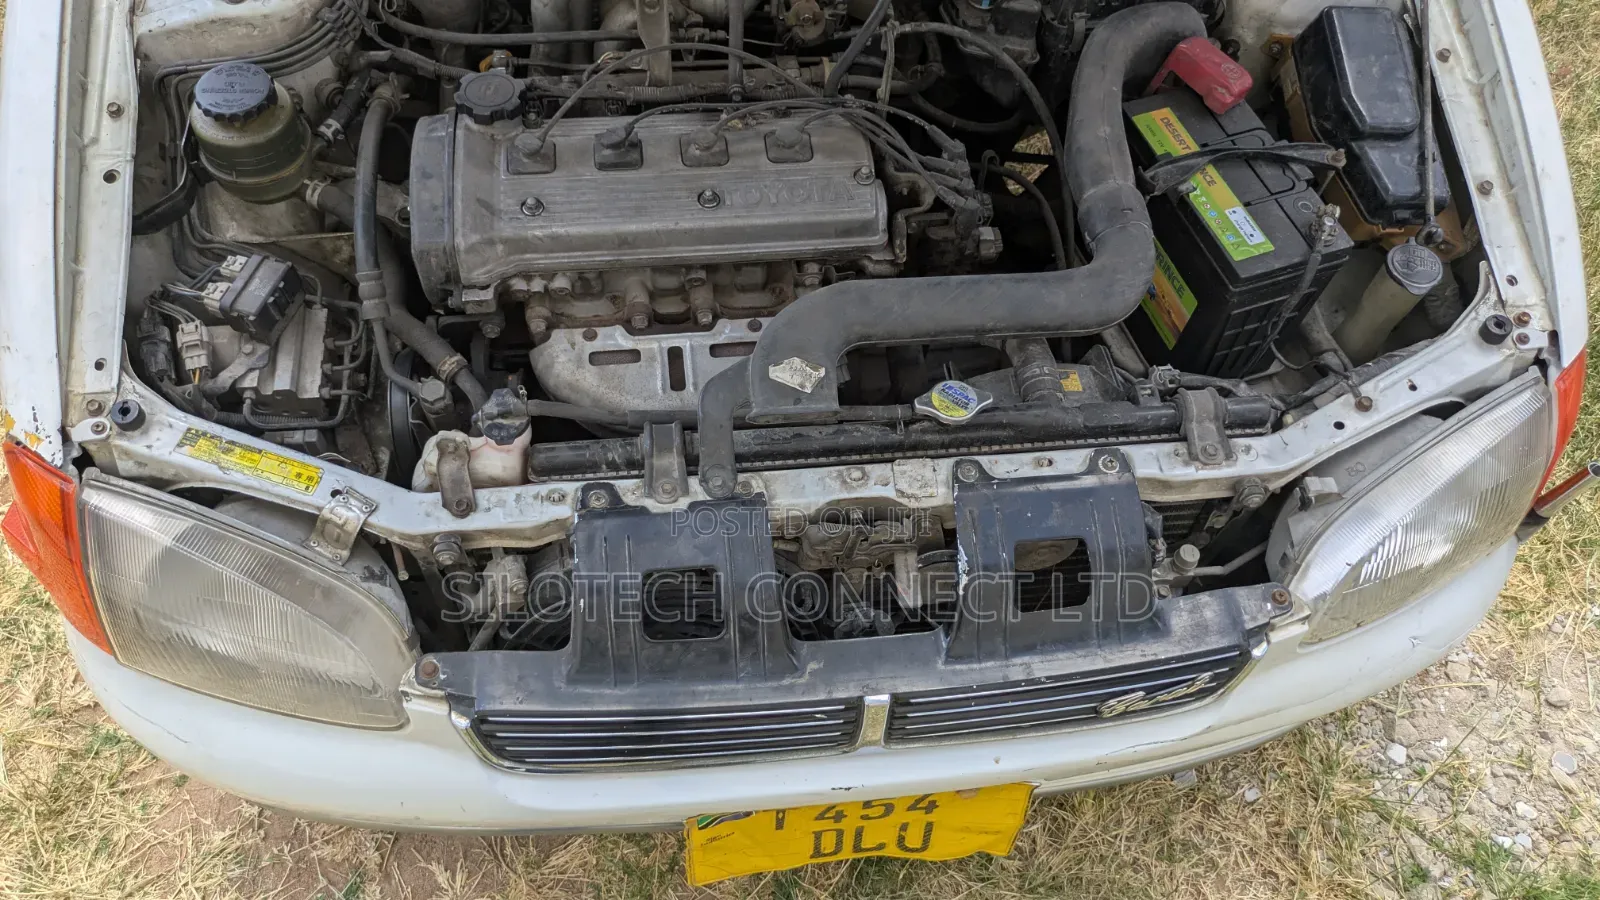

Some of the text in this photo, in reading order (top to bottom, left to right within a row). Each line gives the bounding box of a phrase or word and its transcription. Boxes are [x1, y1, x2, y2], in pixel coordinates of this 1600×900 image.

[1160, 117, 1192, 151] DESERT
[722, 180, 855, 206] TOYOTA
[813, 794, 940, 823] 454
[809, 821, 935, 860] DLU
